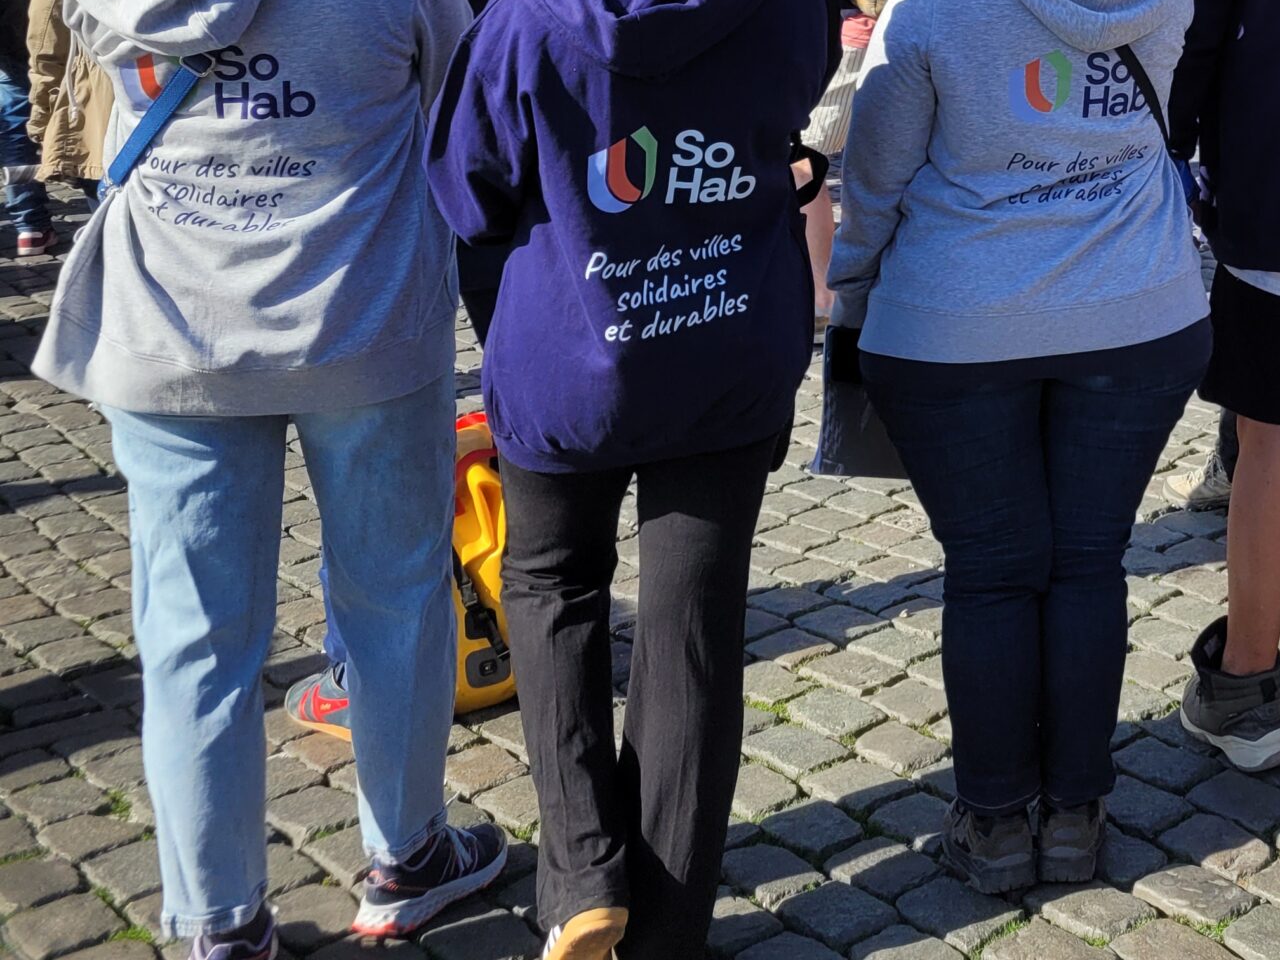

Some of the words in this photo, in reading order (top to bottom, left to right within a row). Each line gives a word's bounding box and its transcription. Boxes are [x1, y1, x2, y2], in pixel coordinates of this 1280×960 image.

[213, 45, 279, 81] So
[1085, 52, 1132, 85] So
[215, 80, 316, 120] Hab
[1082, 83, 1147, 118] Hab
[196, 156, 240, 178] des
[251, 156, 317, 178] villes
[671, 129, 735, 169] So
[1006, 152, 1060, 172] Pour
[1066, 151, 1098, 173] des
[1105, 144, 1149, 165] villes
[664, 166, 756, 205] Hab
[585, 252, 641, 280] Pour
[646, 244, 683, 271] des
[690, 234, 743, 261] villes
[617, 269, 727, 312] solidaires
[604, 319, 633, 341] et
[641, 291, 749, 340] durables
